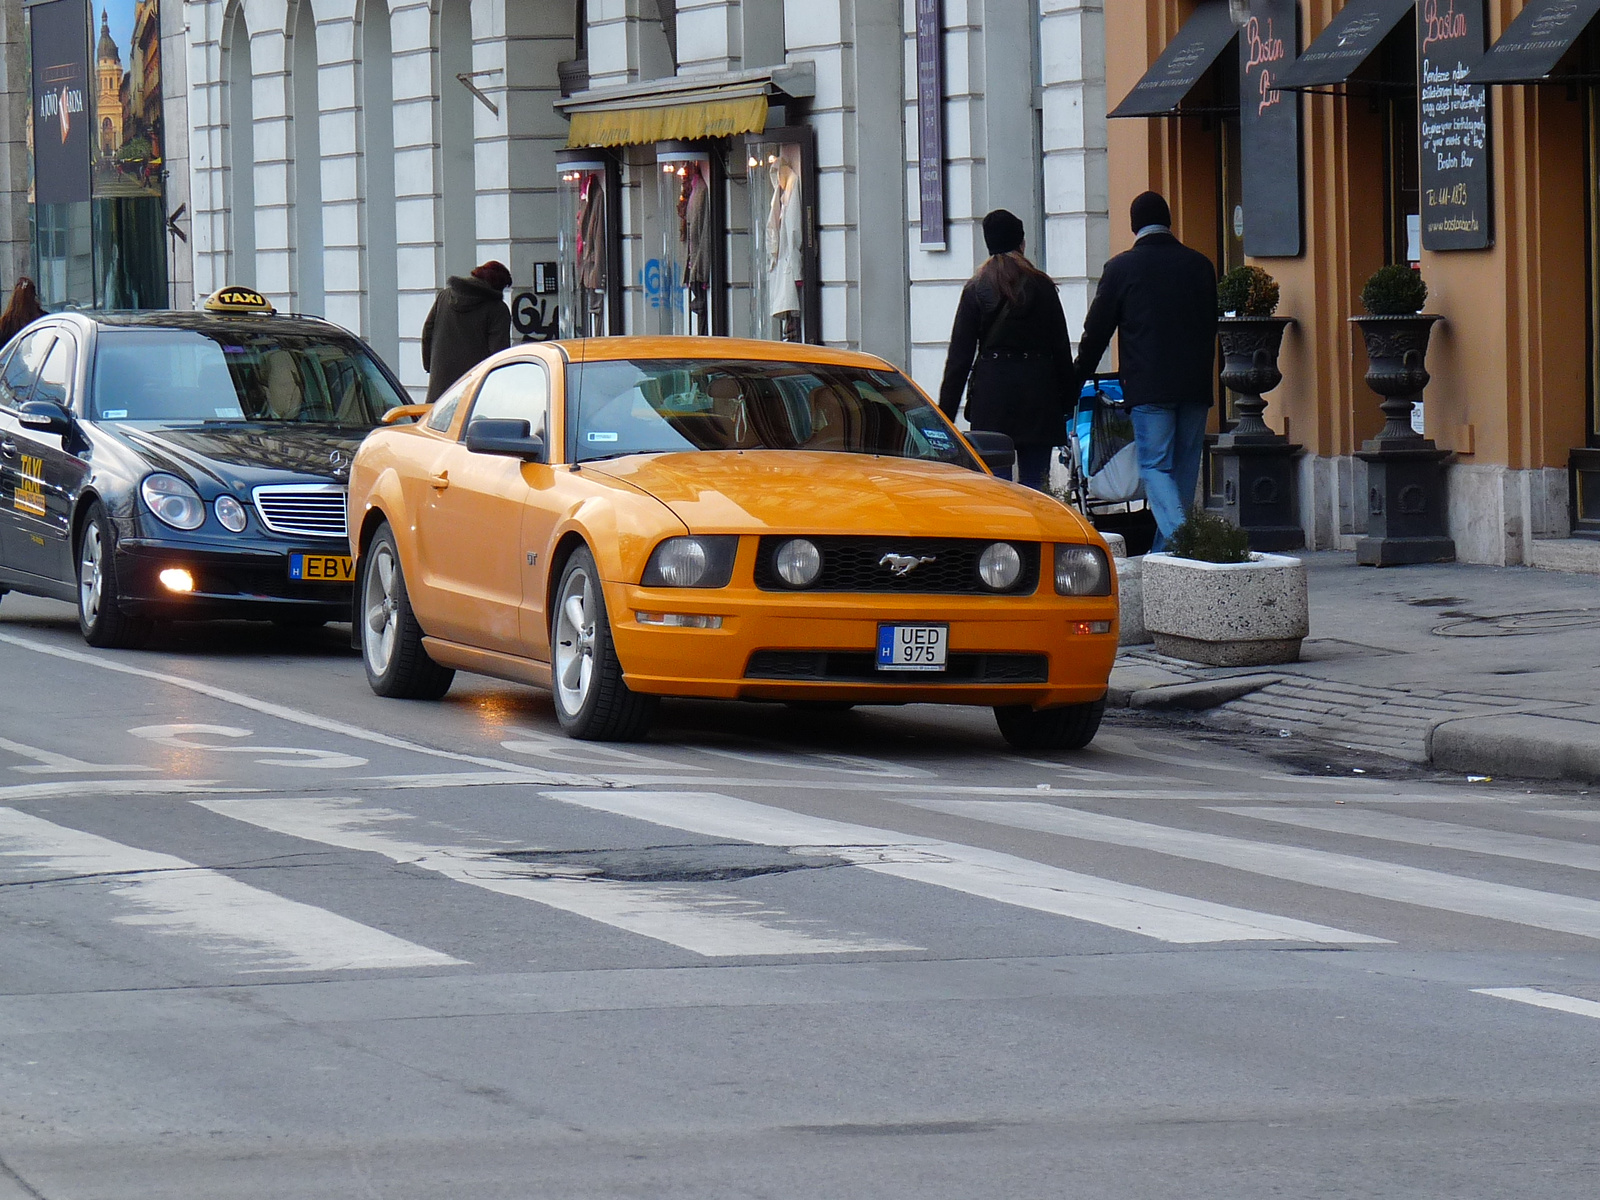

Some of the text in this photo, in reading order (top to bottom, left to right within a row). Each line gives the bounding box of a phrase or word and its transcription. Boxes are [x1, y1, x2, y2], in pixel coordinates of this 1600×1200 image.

[1423, 0, 1467, 54] Boston
[1243, 17, 1284, 74] Boston
[1437, 150, 1474, 171] Boston Bar
[220, 292, 263, 305] TAXI
[21, 455, 43, 494] TAXI
[292, 568, 300, 576] H
[902, 628, 939, 645] UED
[882, 646, 935, 662] H 975
